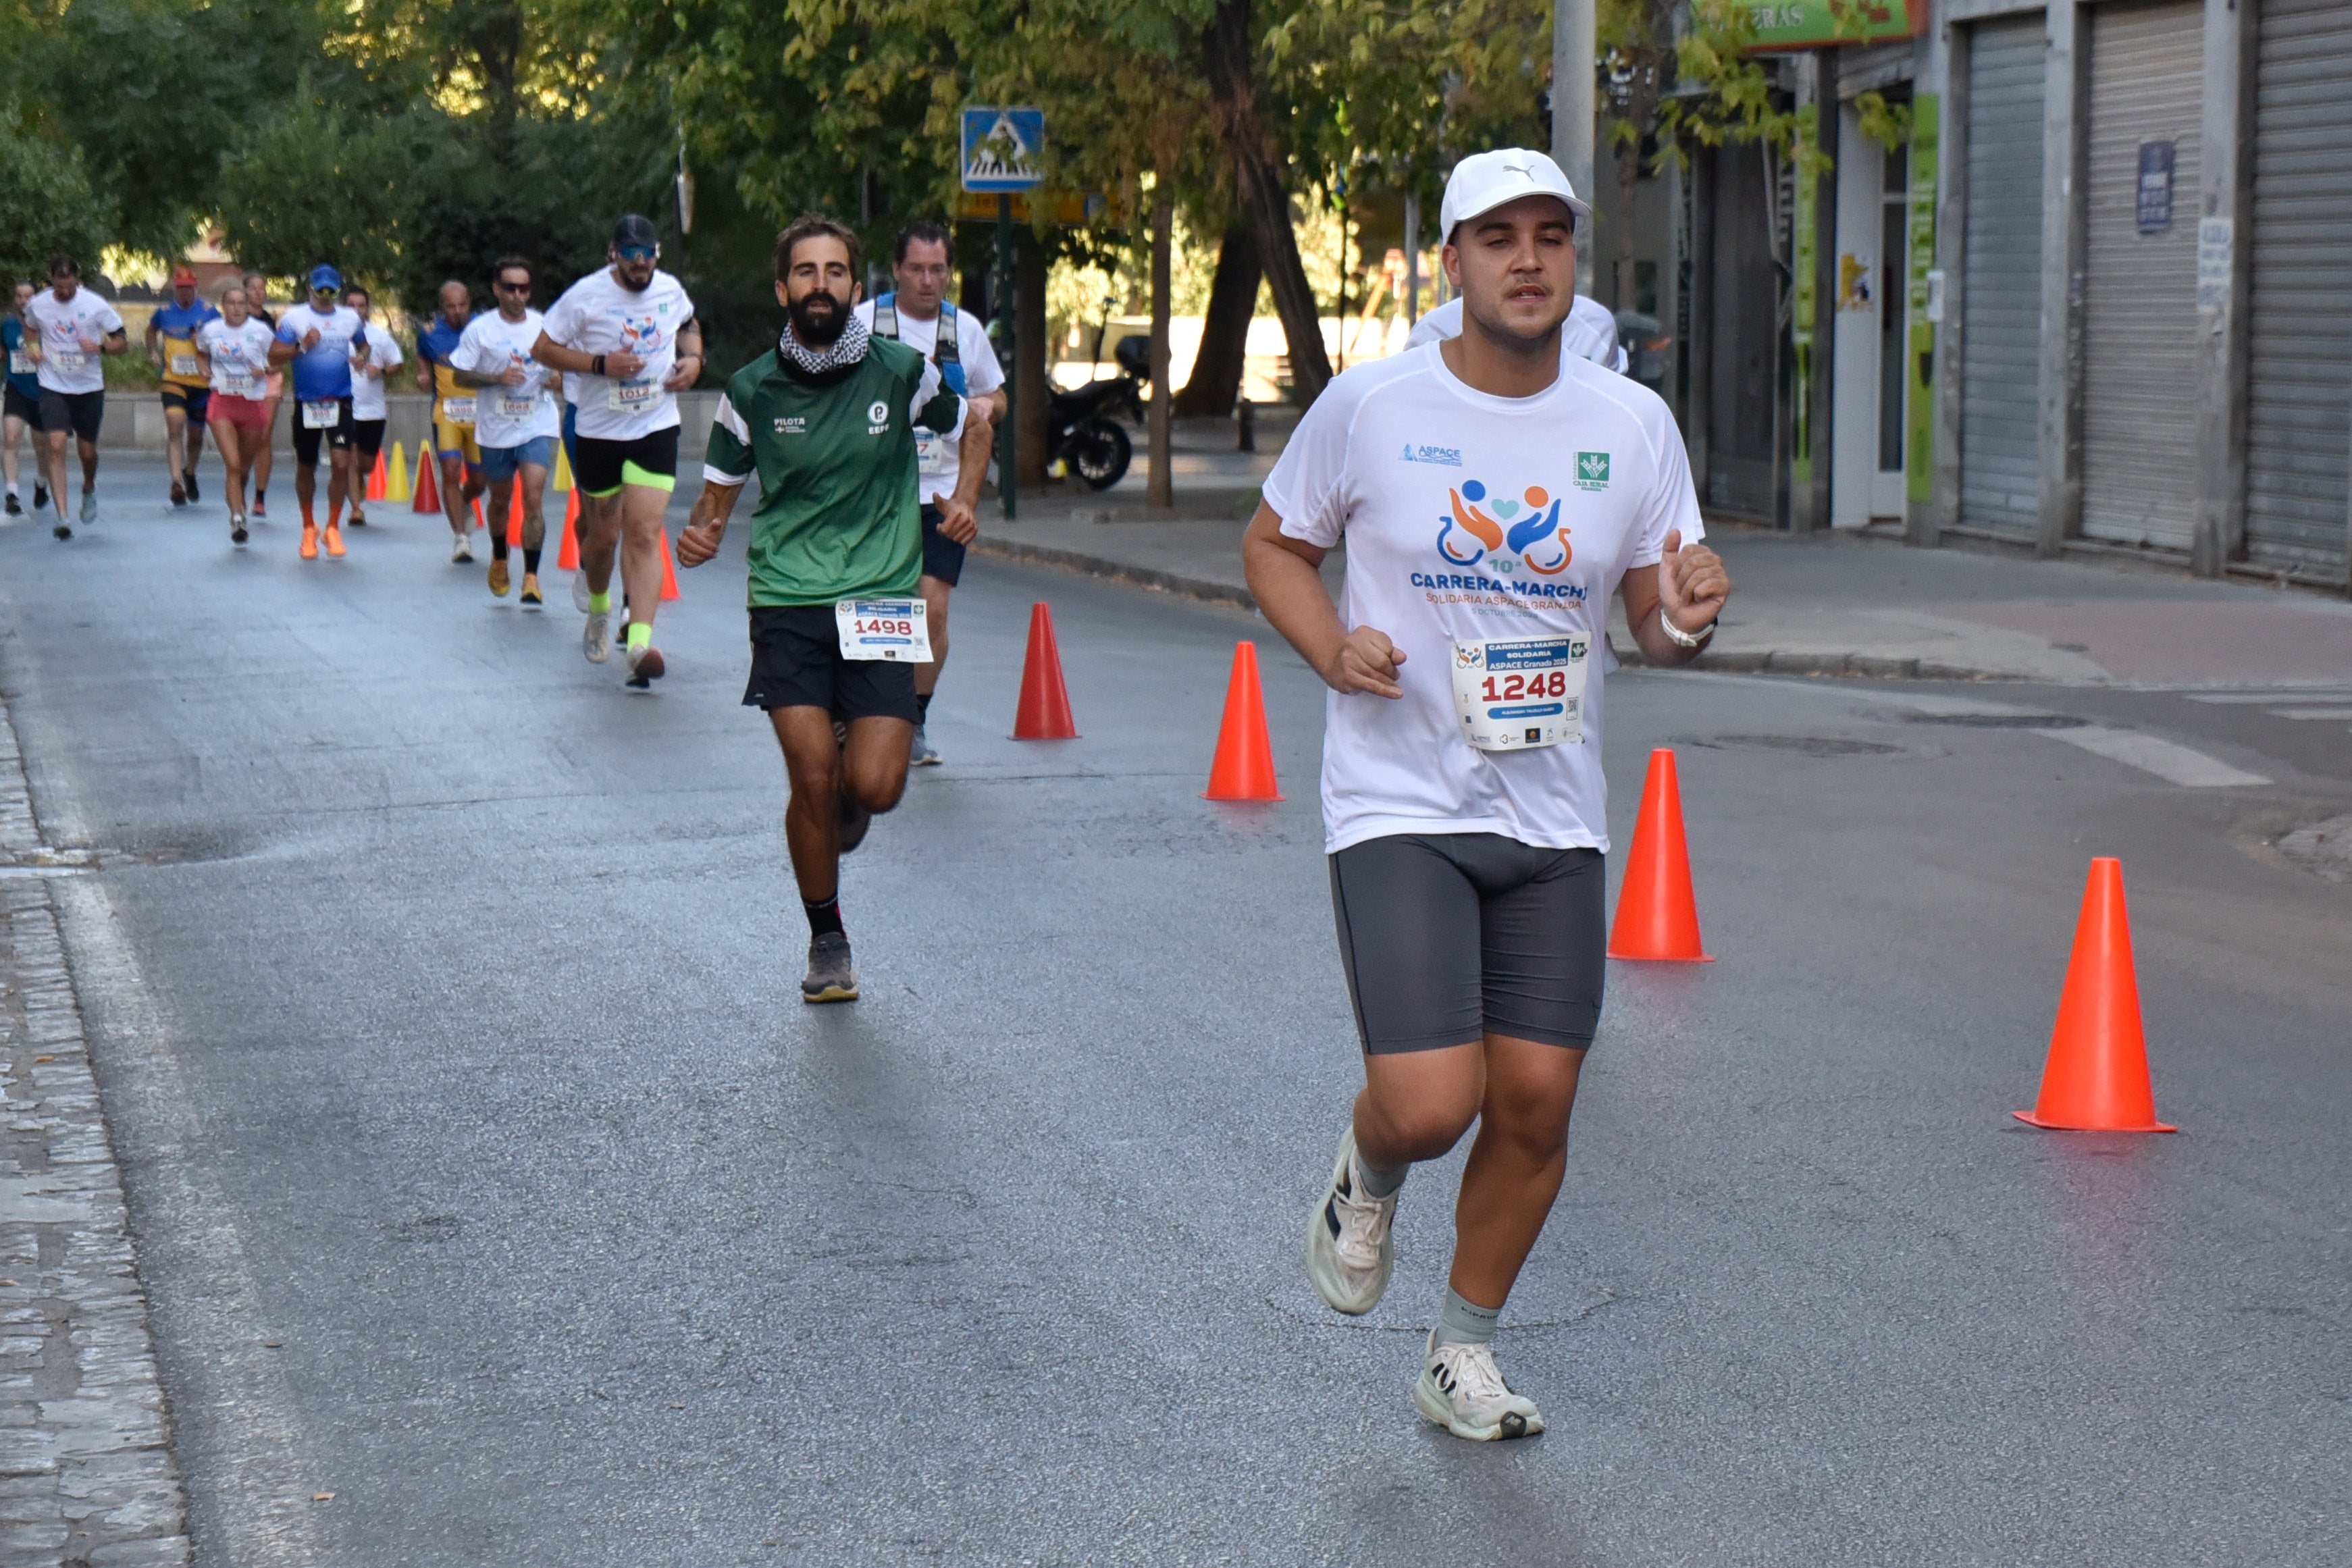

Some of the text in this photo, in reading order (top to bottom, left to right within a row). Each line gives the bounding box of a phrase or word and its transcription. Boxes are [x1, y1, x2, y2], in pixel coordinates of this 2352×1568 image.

[1419, 446, 1460, 457] ASPACE
[1426, 593, 1482, 604] SOLIDARIA
[1486, 596, 1530, 609] ASPACE
[1478, 608, 1515, 617] OCTUBRE
[854, 619, 912, 635] 1498
[1488, 640, 1567, 651] CARRERA-MARCHA
[1507, 650, 1552, 659] SOLIDARIA
[1490, 661, 1522, 670] ASPACE
[1523, 660, 1552, 668] Granada
[1553, 658, 1567, 666] 2025
[1482, 671, 1566, 702] 1248
